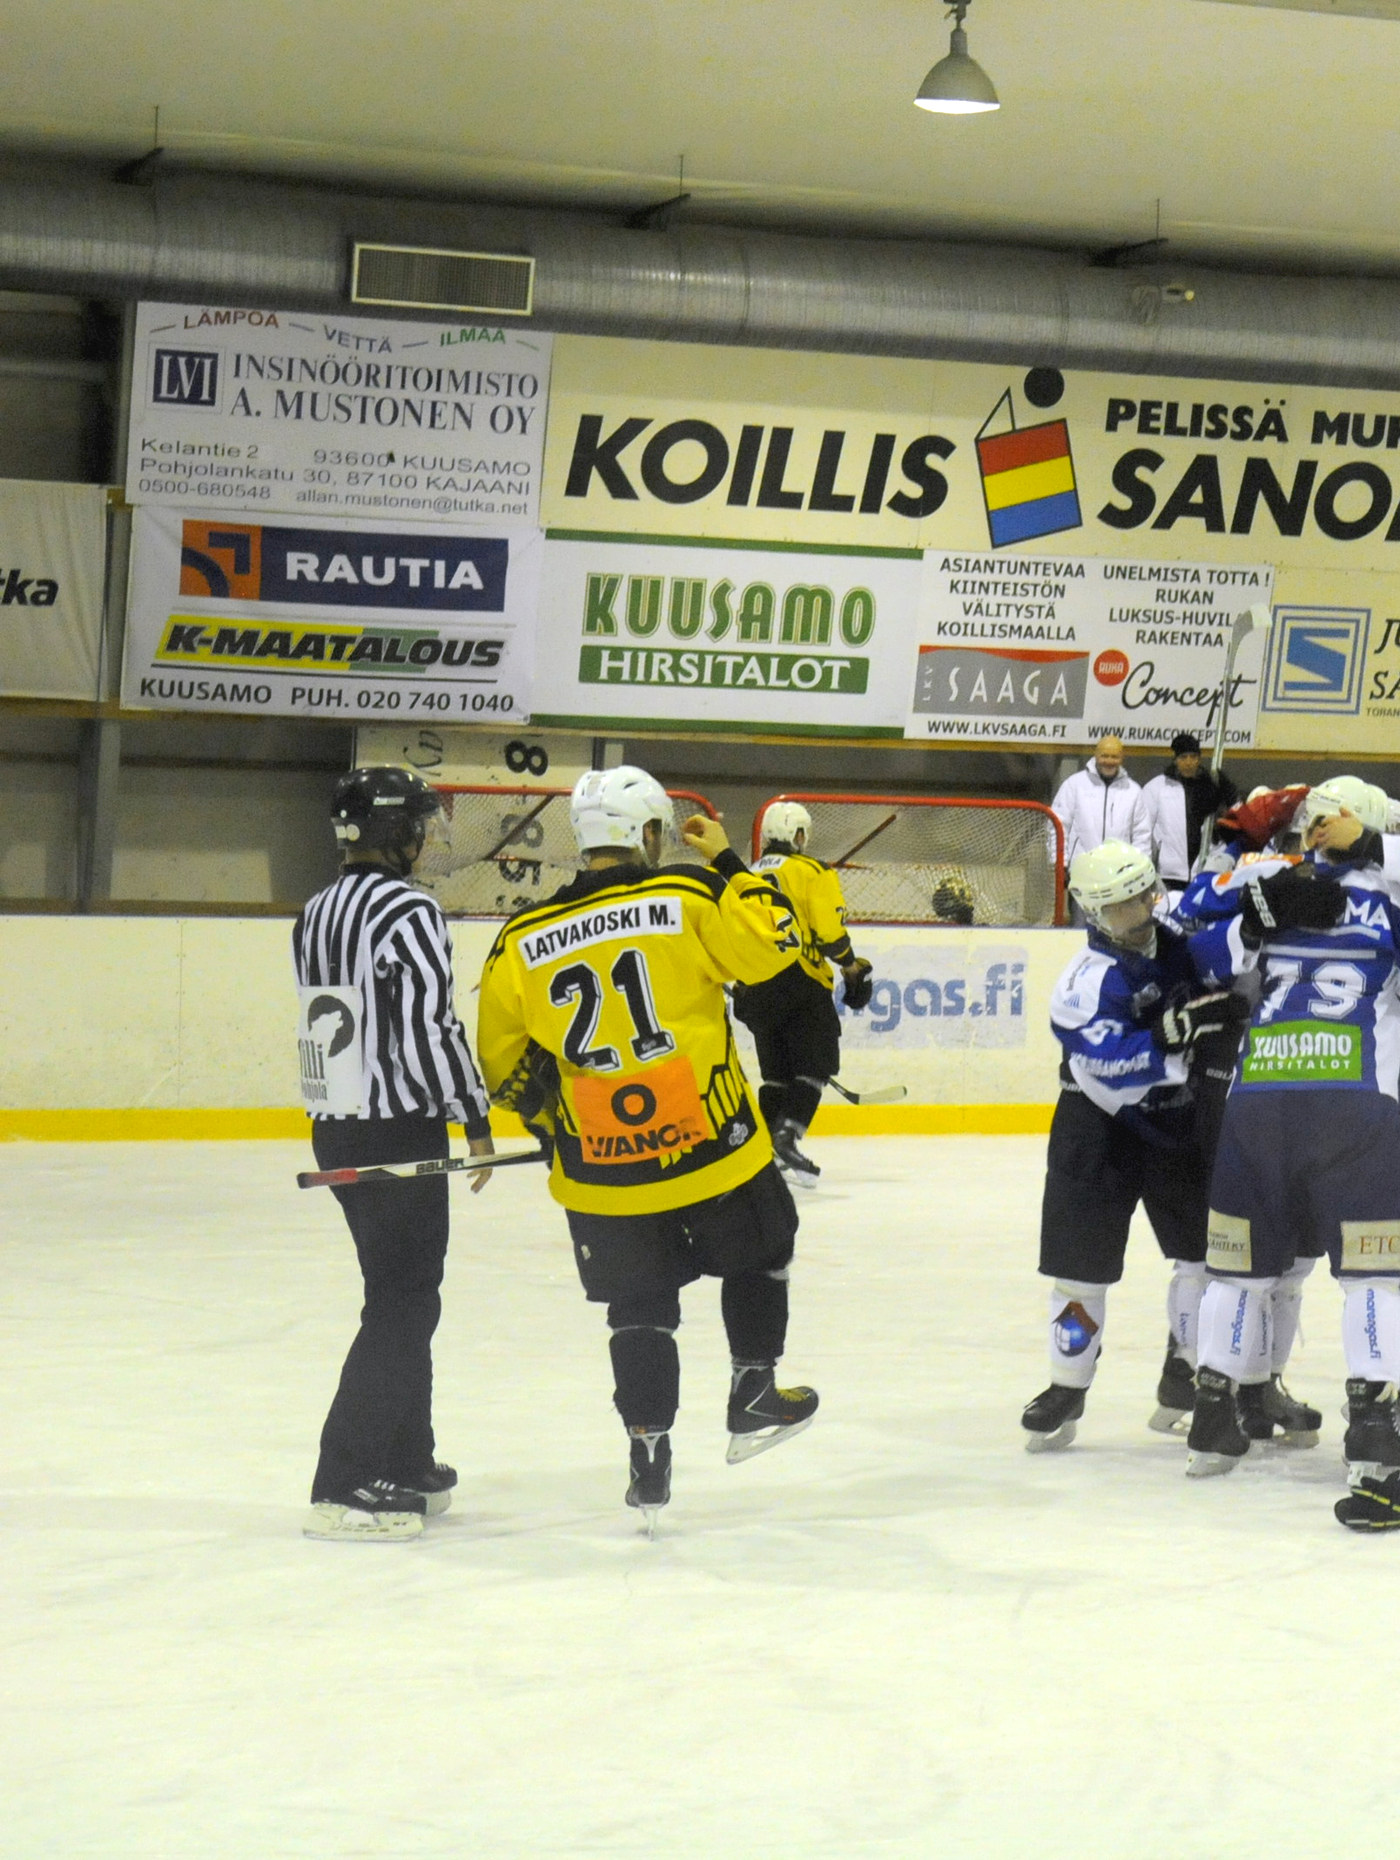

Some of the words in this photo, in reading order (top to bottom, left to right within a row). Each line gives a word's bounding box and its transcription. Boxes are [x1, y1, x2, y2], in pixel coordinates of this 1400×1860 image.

[323, 324, 392, 353] VETTÄ
[440, 327, 506, 347] ILMAA
[159, 354, 214, 401] LVI
[233, 353, 539, 399] INSINÖÖRITOIMISTO
[230, 386, 262, 417] A.
[275, 389, 474, 431] MUSTONEN
[489, 404, 536, 435] OY
[1105, 397, 1289, 443] PELISSÄ
[141, 437, 240, 458] Kelantie
[246, 444, 259, 459] 2
[313, 448, 391, 468] 93600
[402, 454, 531, 477] KUUSAMO
[564, 413, 957, 519] KOILLIS
[138, 478, 272, 500] 0500-680548
[140, 457, 294, 481] Pohjolankatu
[303, 468, 337, 487] 30,
[346, 470, 418, 489] 87100
[425, 476, 531, 496] KAJAANI
[295, 488, 529, 516] allan.mustonen@tutka.net
[285, 551, 485, 591] RAUTIA
[939, 557, 1086, 579] ASIANTUNTEVAA
[1103, 564, 1201, 583] UNELMISTA
[1206, 569, 1260, 587] TOTTA
[0, 568, 60, 607] ka
[949, 579, 1066, 599] KIINTEISTÖN
[1155, 588, 1215, 605] RUKAN
[582, 572, 877, 649] KUUSAMO
[962, 598, 1056, 620] VÄLITYSTÄ
[1108, 607, 1233, 628] LUKSUS-HUVIL
[165, 623, 505, 668] K-MAATALOUS
[936, 621, 1076, 641] KOILLISMAALLA
[1135, 629, 1224, 648] RAKENTAA
[598, 650, 852, 691] HIRSITALOT
[948, 666, 1069, 706] SAAGA
[1099, 661, 1124, 675] RUKA
[139, 677, 273, 705] KUUSAMO
[291, 686, 350, 709] PUH.
[356, 689, 402, 711] 020
[407, 690, 451, 712] 740
[459, 693, 515, 714] 1040
[1121, 660, 1257, 728] Concept
[926, 720, 1068, 738] WWW.LKVSAAGA.FI
[524, 906, 642, 963] LATVAKOSKI
[649, 904, 676, 926] M.
[1259, 957, 1367, 1025] 79
[548, 949, 676, 1073] 21
[1249, 1059, 1351, 1072] HIRSITALOT
[1364, 1287, 1382, 1360] marengas.fi
